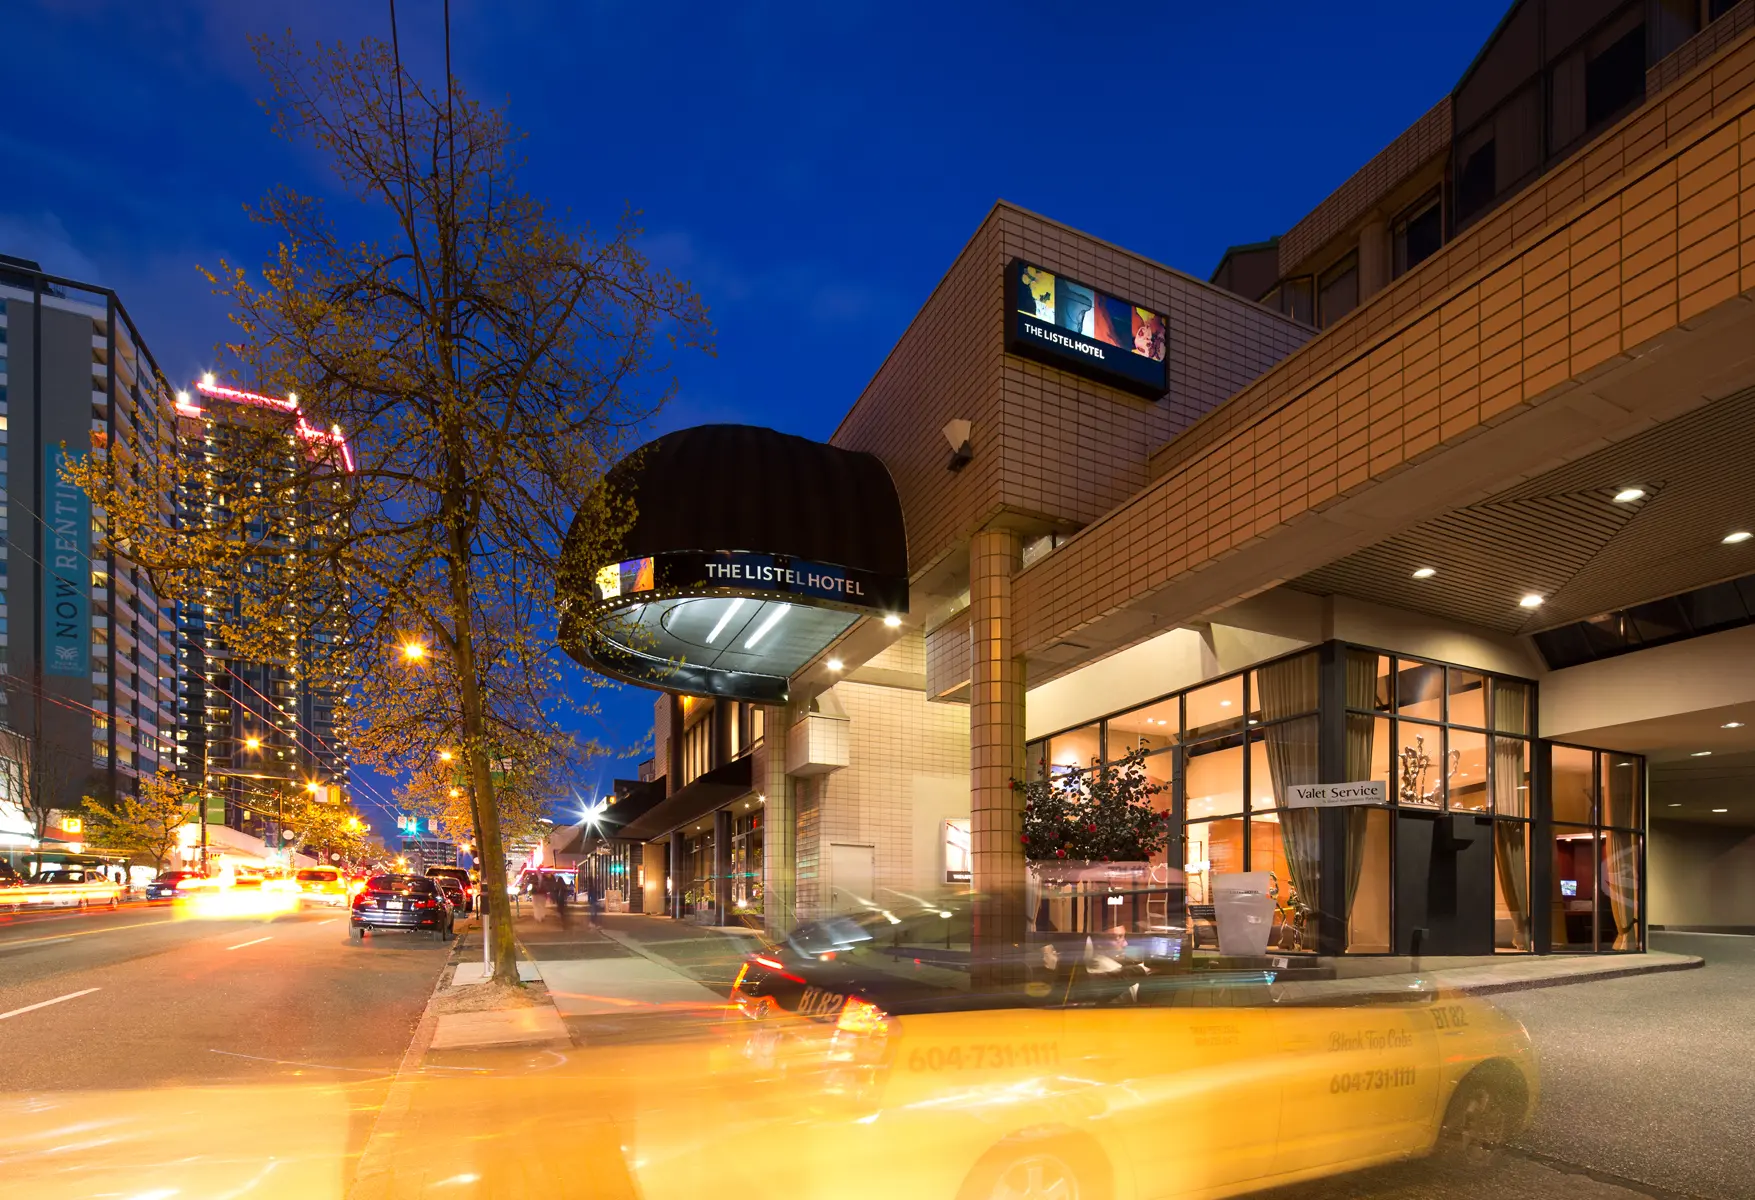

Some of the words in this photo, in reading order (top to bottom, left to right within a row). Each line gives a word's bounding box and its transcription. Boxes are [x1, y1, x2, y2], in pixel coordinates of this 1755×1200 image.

[1024, 323, 1043, 338] THE
[1044, 330, 1074, 349] LISTEL
[1075, 341, 1105, 360] HOTEL
[705, 563, 742, 579] THE
[745, 565, 806, 586] LISTEL
[808, 573, 865, 596] HOTEL
[56, 577, 78, 640] NOW
[1296, 787, 1326, 799] Valet
[1331, 786, 1378, 799] Service
[816, 991, 844, 1016] 82
[1430, 1006, 1450, 1030] BT
[1449, 1005, 1469, 1027] 82
[1328, 1030, 1364, 1053] Black
[1365, 1030, 1386, 1055] Top
[1388, 1028, 1413, 1049] Cabs
